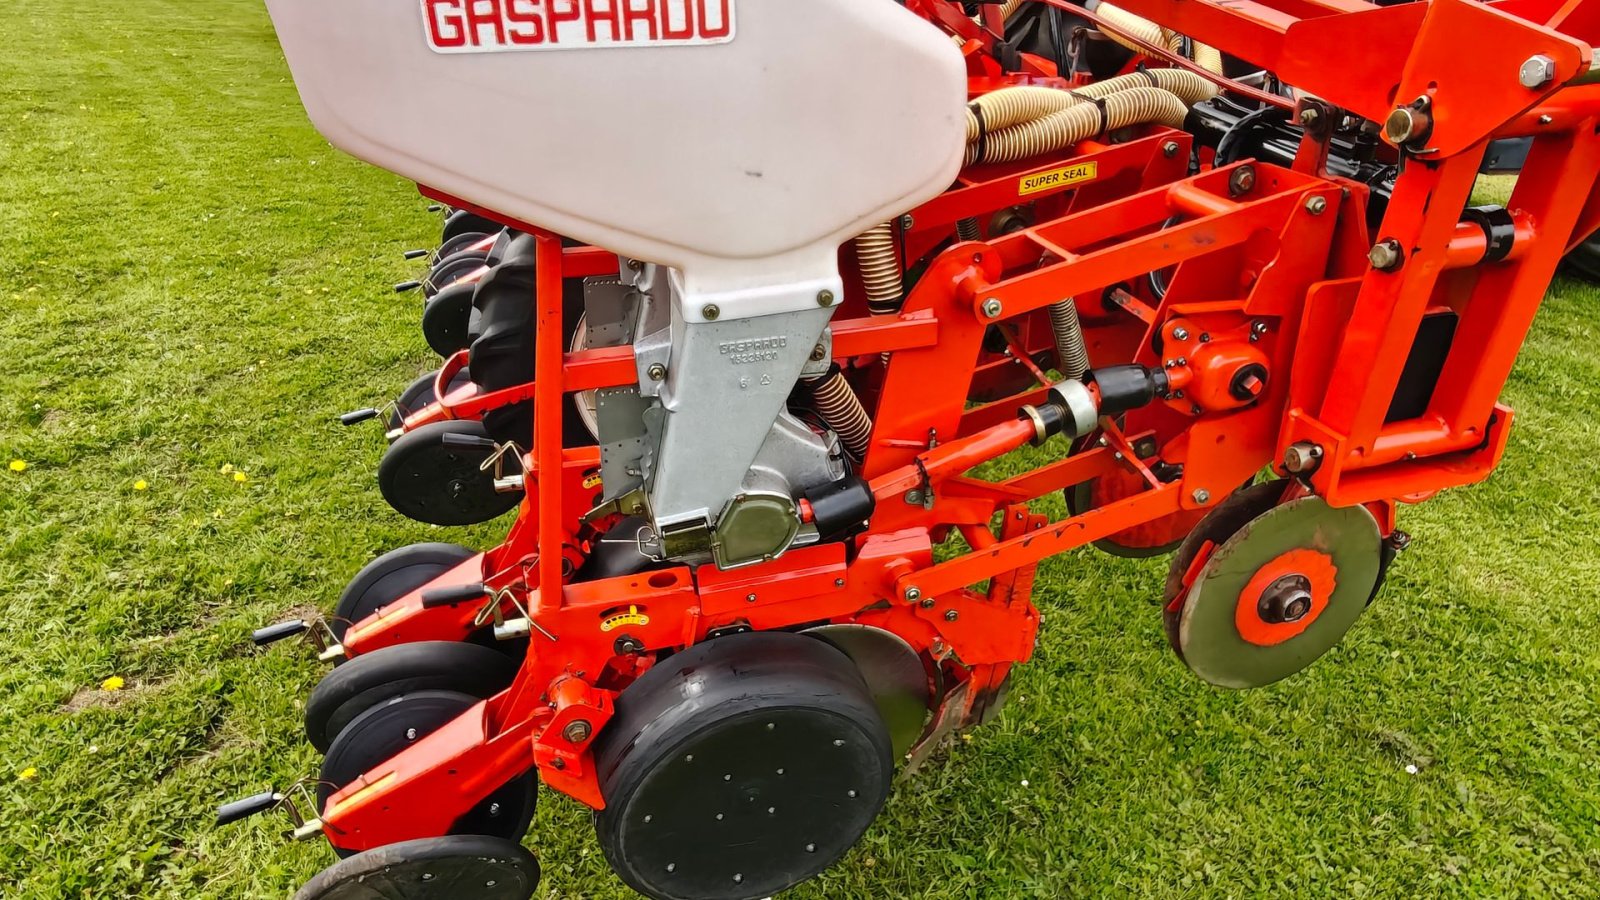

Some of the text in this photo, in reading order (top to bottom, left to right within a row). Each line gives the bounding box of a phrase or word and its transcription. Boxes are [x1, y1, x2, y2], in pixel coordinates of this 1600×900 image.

[425, 0, 729, 47] GASPARDO
[1024, 167, 1088, 189] SUPER SEAL
[719, 336, 787, 354] GASPARDO
